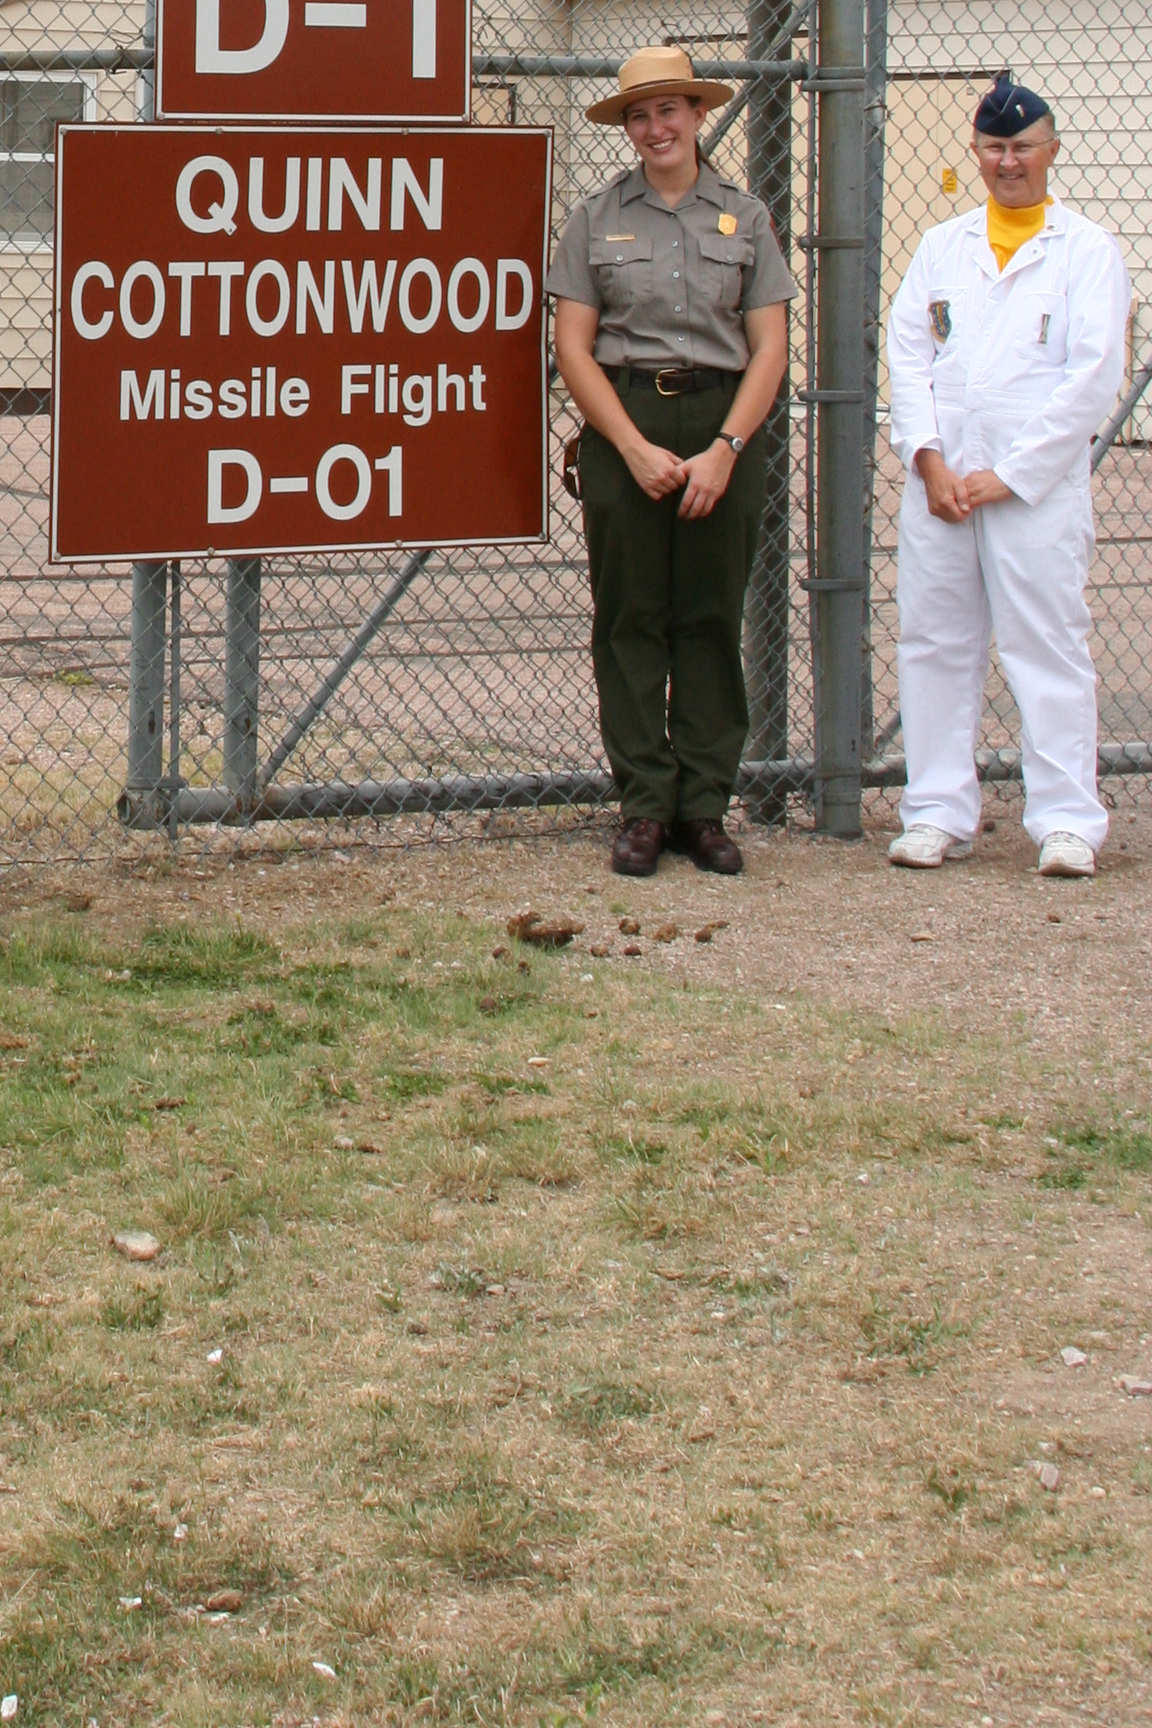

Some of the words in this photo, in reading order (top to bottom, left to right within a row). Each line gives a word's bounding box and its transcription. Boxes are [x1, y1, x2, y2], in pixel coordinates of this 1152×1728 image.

[175, 155, 444, 236] QUINN
[70, 257, 534, 340] COTTONWOOD
[119, 366, 310, 421] Missile
[341, 363, 487, 427] Flight
